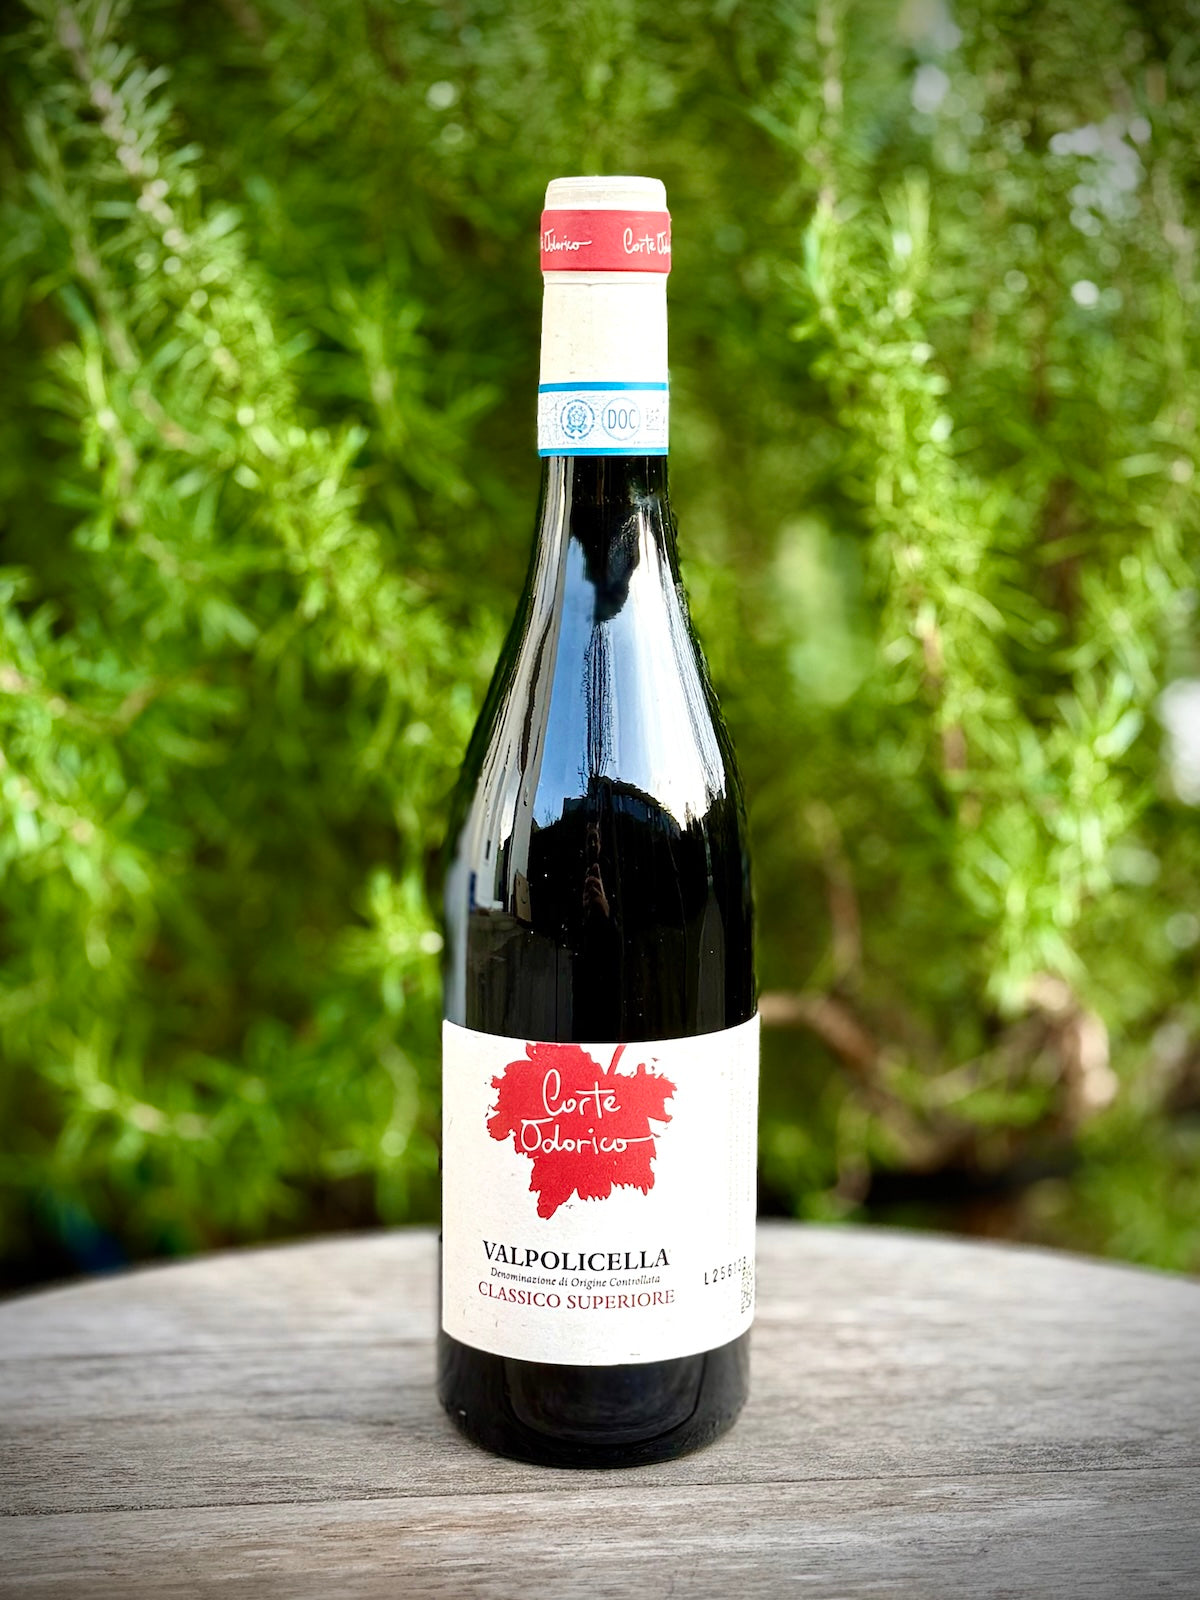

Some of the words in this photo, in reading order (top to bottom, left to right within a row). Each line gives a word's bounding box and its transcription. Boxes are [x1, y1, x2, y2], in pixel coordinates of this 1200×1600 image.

[623, 227, 656, 254] Corte
[608, 409, 636, 429] DOC
[543, 1069, 621, 1118] Corte
[521, 1118, 654, 1154] Odorico
[482, 1240, 670, 1271] VALPOLICELLA
[490, 1267, 556, 1286] Denominazione
[559, 1276, 567, 1287] di
[571, 1278, 606, 1290] Origine
[609, 1275, 660, 1287] Controllata
[478, 1281, 561, 1308] CLASSICO
[566, 1290, 675, 1309] SUPERIORE
